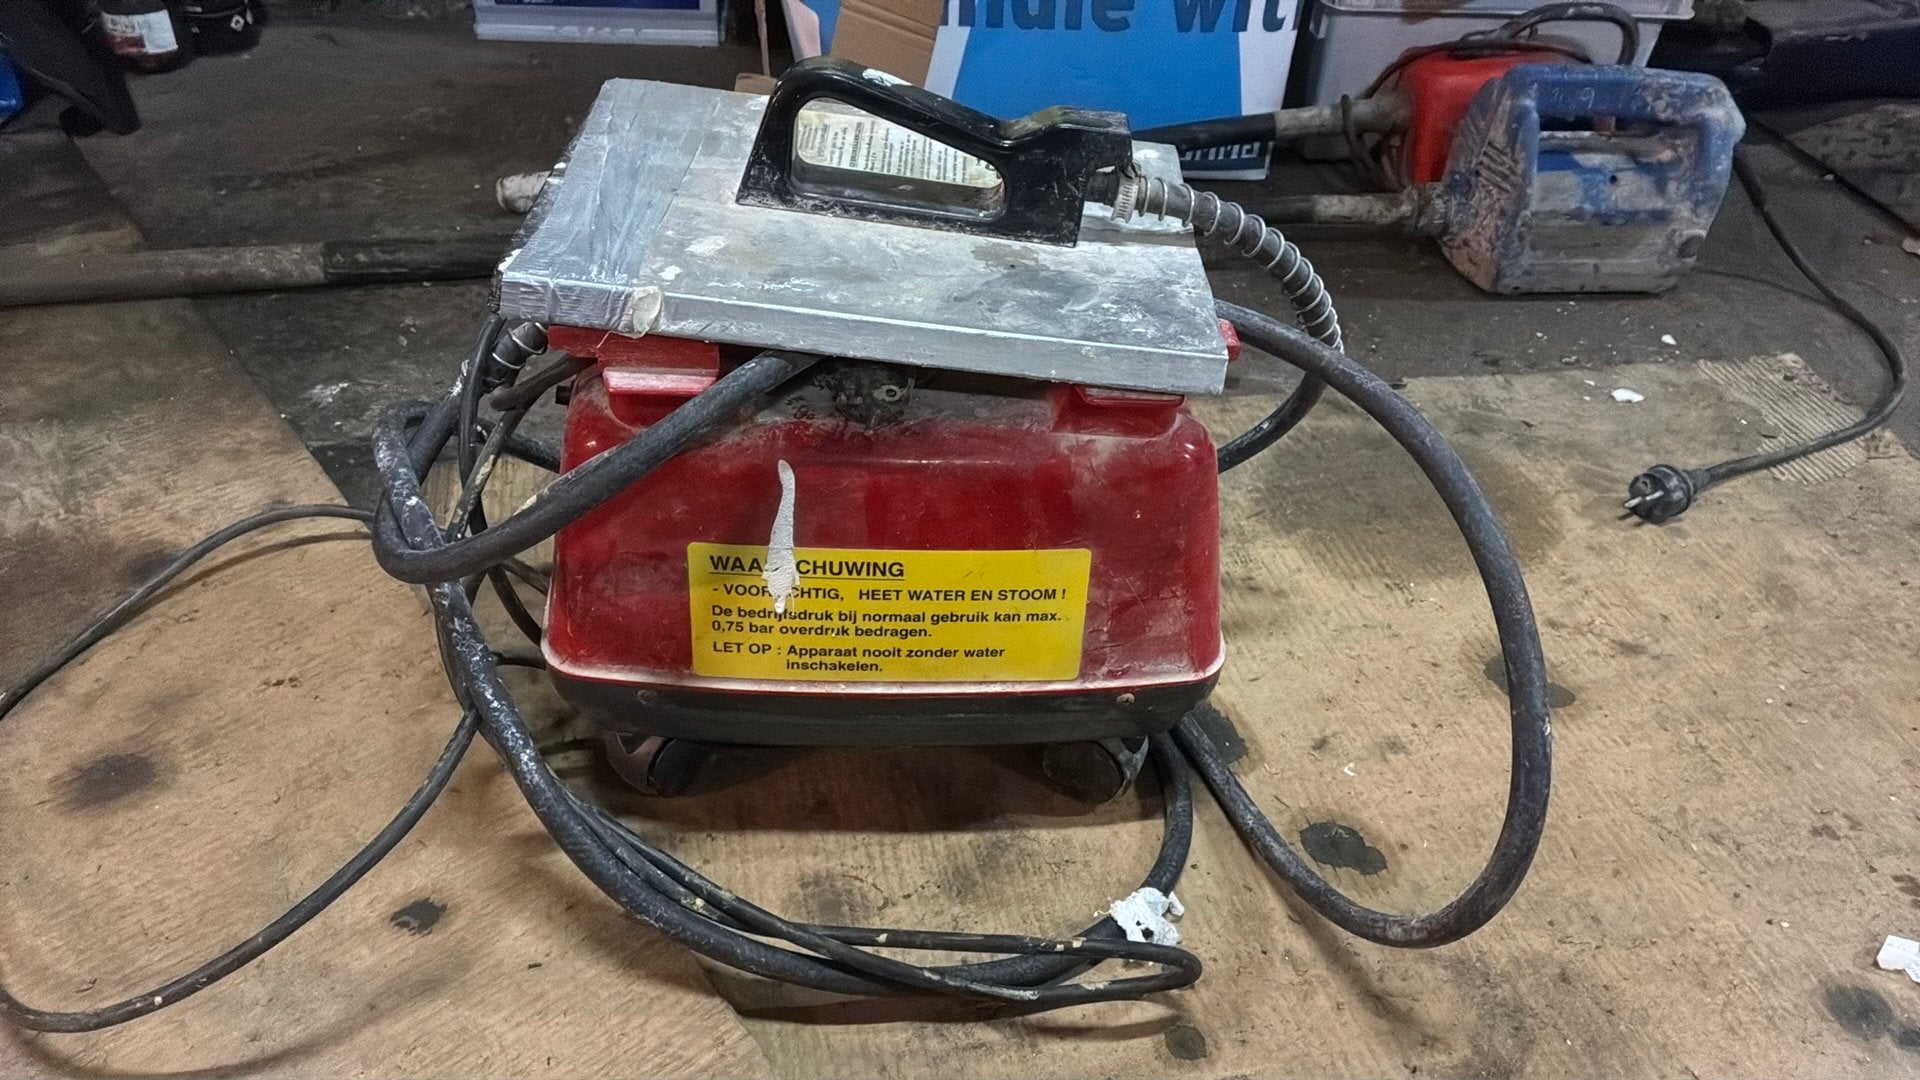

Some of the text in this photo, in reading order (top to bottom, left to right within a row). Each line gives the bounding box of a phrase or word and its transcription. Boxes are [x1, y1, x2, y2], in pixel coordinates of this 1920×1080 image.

[710, 555, 905, 577] WAACHUWING
[723, 584, 844, 601] VOORCHTIG,
[859, 589, 903, 601] HEET
[908, 590, 966, 601] WATER
[971, 590, 993, 601] EN
[997, 589, 1057, 600] STOOM
[712, 605, 1062, 625] De bedrijfsdruk bij normaal gebruik kan max.
[712, 620, 932, 640] 0,75 bar overdruk bedragen.
[713, 641, 744, 653] LET
[749, 643, 772, 655] OP
[786, 645, 857, 658] Apparaat
[862, 646, 902, 657] nooit
[906, 647, 959, 658] zonder
[964, 648, 1006, 658] water
[786, 659, 883, 672] inschakelen.
